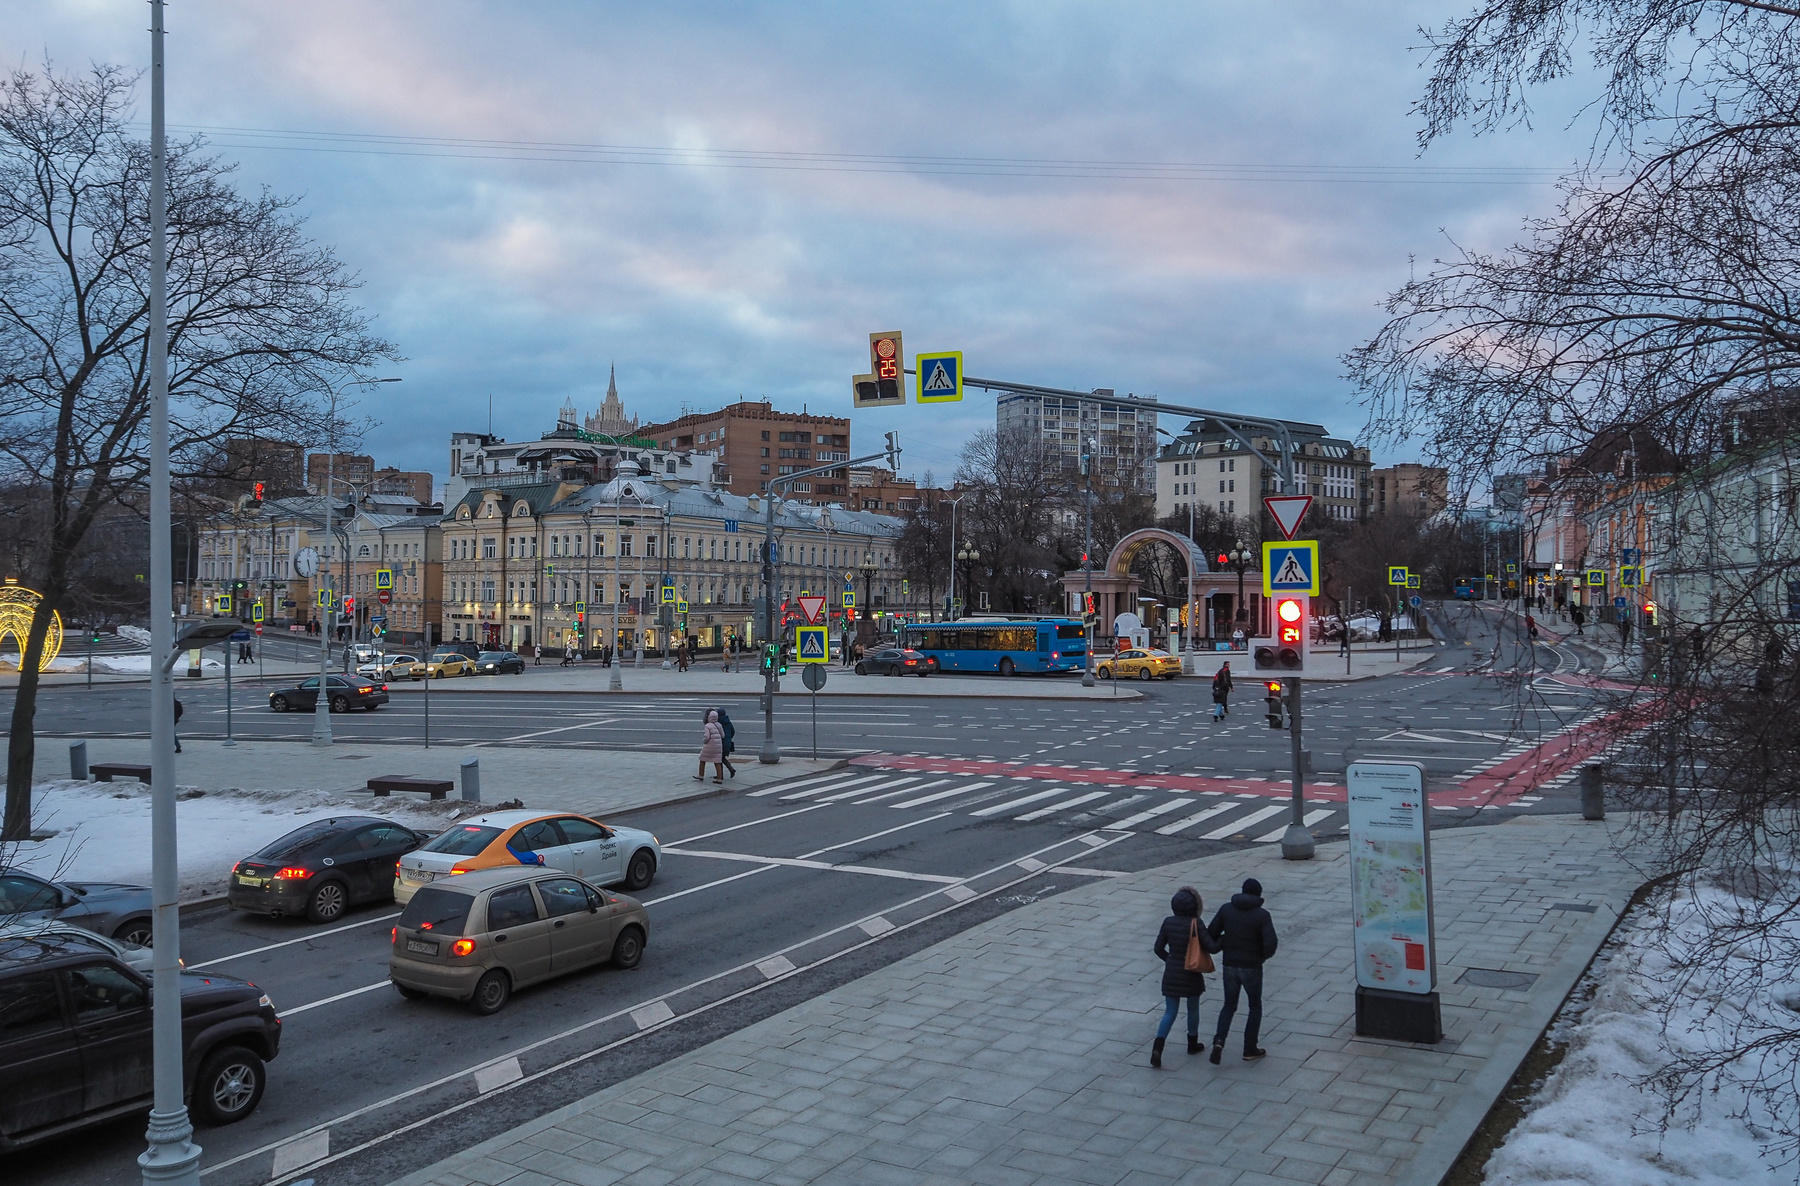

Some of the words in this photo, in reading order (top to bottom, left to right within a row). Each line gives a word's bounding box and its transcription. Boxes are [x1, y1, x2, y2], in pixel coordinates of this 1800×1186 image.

[880, 360, 897, 377] 25
[1283, 627, 1300, 642] 24
[1122, 664, 1141, 673] Uber
[599, 842, 617, 851] Яндекс
[601, 851, 618, 861] Драйв
